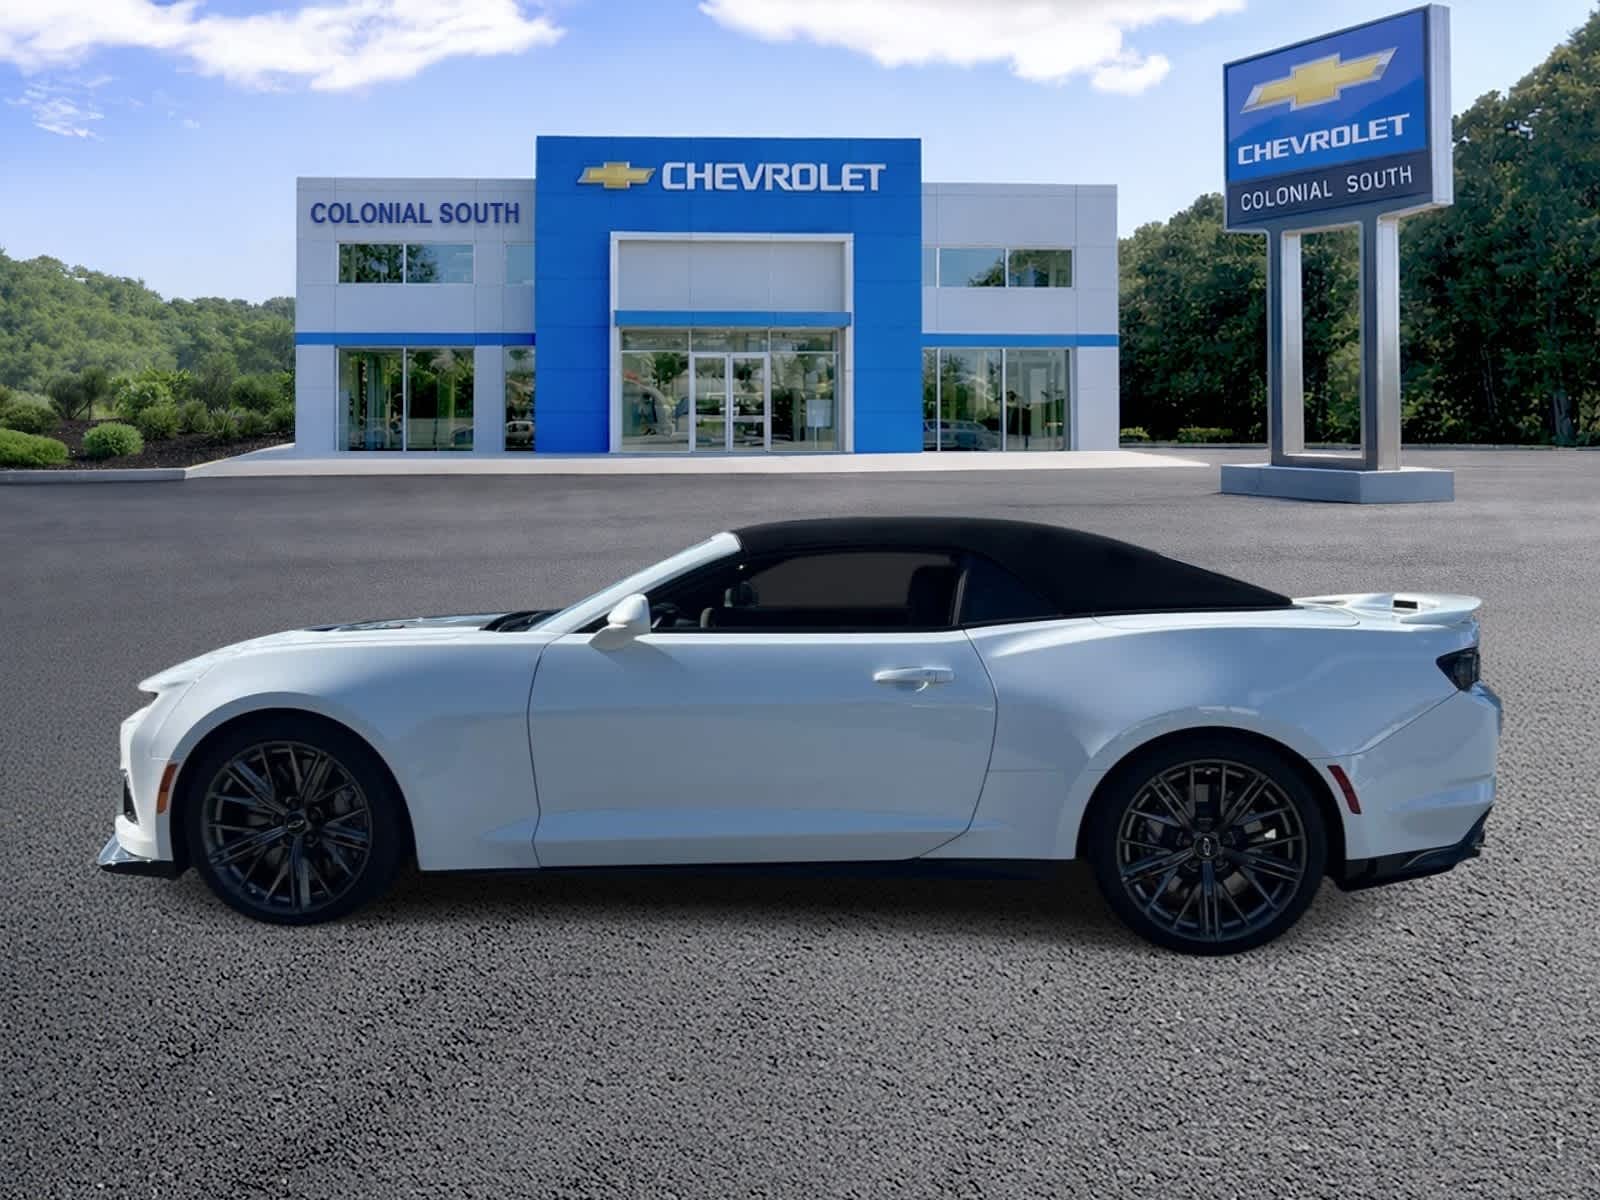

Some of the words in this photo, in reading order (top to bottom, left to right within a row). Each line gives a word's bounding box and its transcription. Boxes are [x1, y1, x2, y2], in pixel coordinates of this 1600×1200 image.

[1237, 113, 1410, 165] CHEVROLET
[661, 161, 887, 192] CHEVROLET
[1240, 179, 1333, 211] COLONIAL
[1346, 165, 1413, 194] SOUTH
[310, 202, 433, 225] COLONIAL
[439, 202, 521, 225] SOUTH
